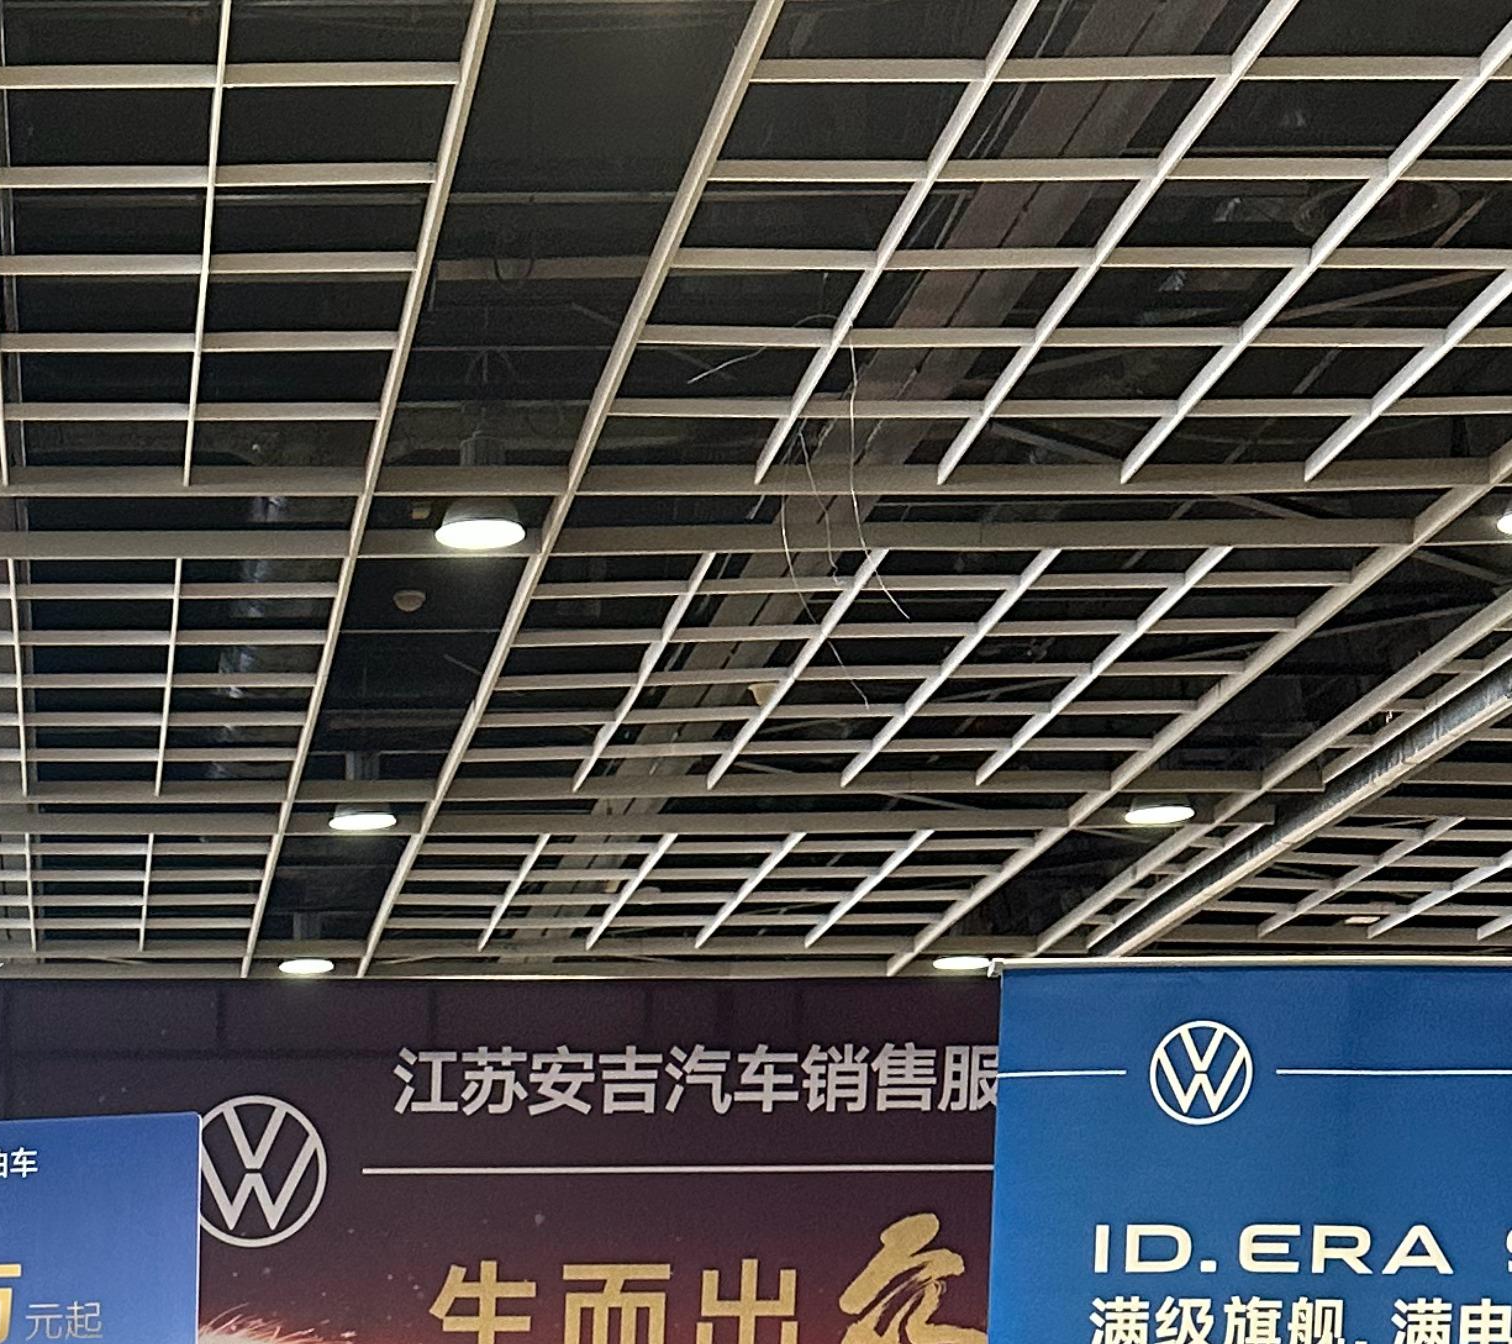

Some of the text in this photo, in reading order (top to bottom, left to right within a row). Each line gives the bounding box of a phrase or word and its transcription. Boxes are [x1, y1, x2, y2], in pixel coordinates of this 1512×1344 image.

[393, 1042, 999, 1117] 江苏安吉汽车销售服
[1093, 1223, 1454, 1275] ID.ERA
